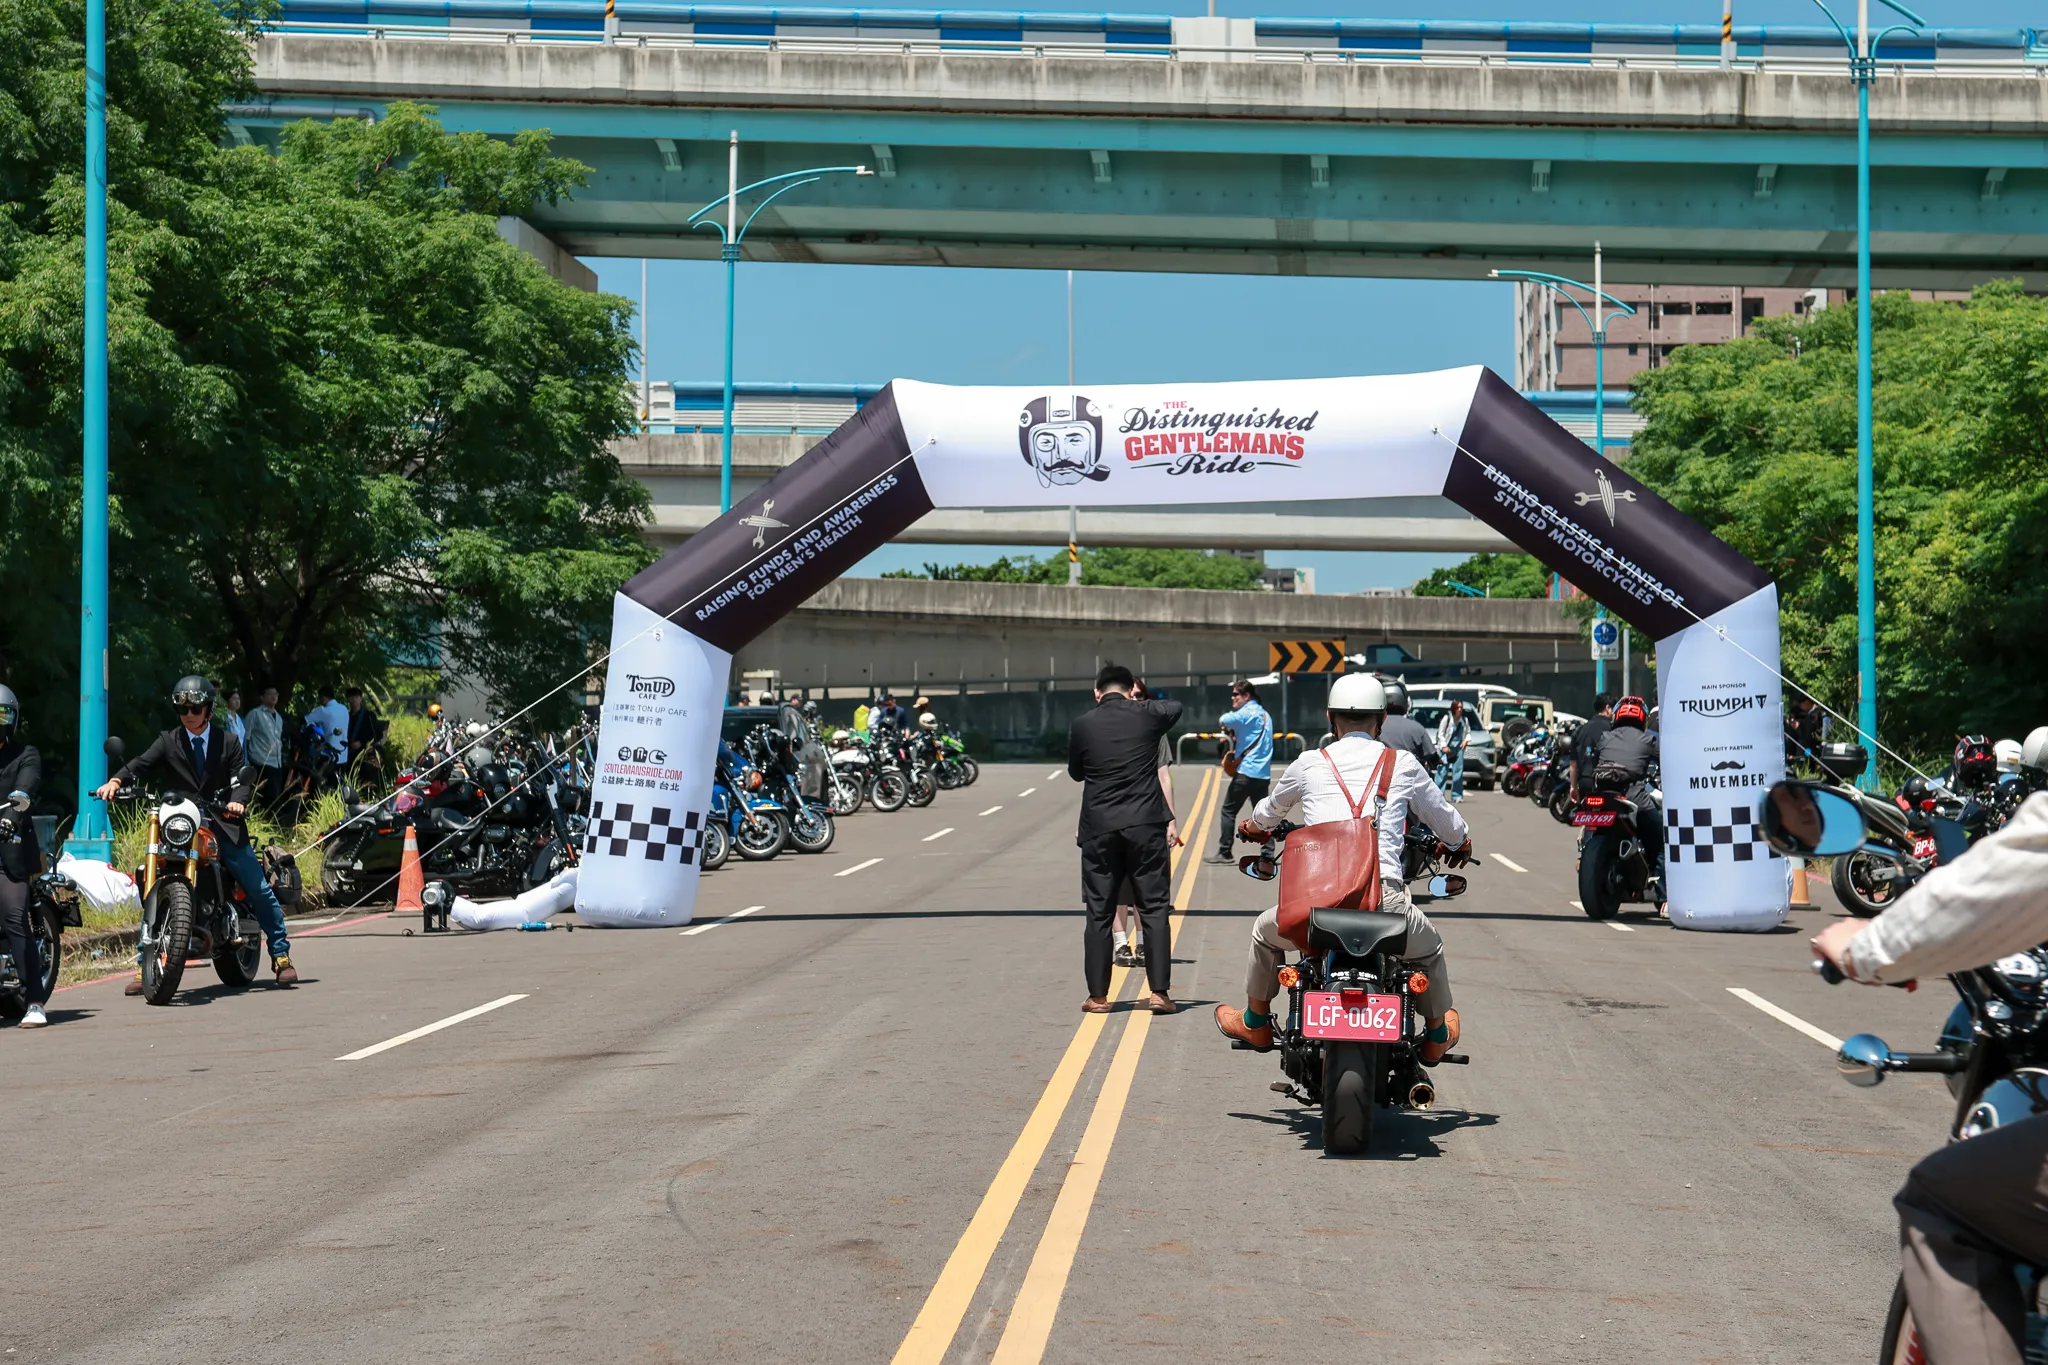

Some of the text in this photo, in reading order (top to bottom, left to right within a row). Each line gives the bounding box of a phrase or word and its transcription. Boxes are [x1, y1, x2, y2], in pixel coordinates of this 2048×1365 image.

[1163, 401, 1188, 410] THE
[1119, 406, 1319, 437] Distinguished
[1166, 453, 1257, 476] Ride
[695, 474, 898, 621] RAISING FUNDS AND AWARENESS
[1483, 464, 1539, 508] RIDING
[1541, 505, 1602, 551] CLASSIC
[1619, 556, 1685, 609] VINTAGE
[1493, 490, 1655, 605] STYLED MOTORCYCLES
[747, 580, 775, 600] FOR
[816, 515, 863, 552] HEALTH
[668, 708, 688, 717] CAFE
[1680, 697, 1753, 717] TRIUMPH
[603, 763, 683, 781] GENTLEMANSRIDE.COM
[1689, 773, 1765, 790] MOVEMBER
